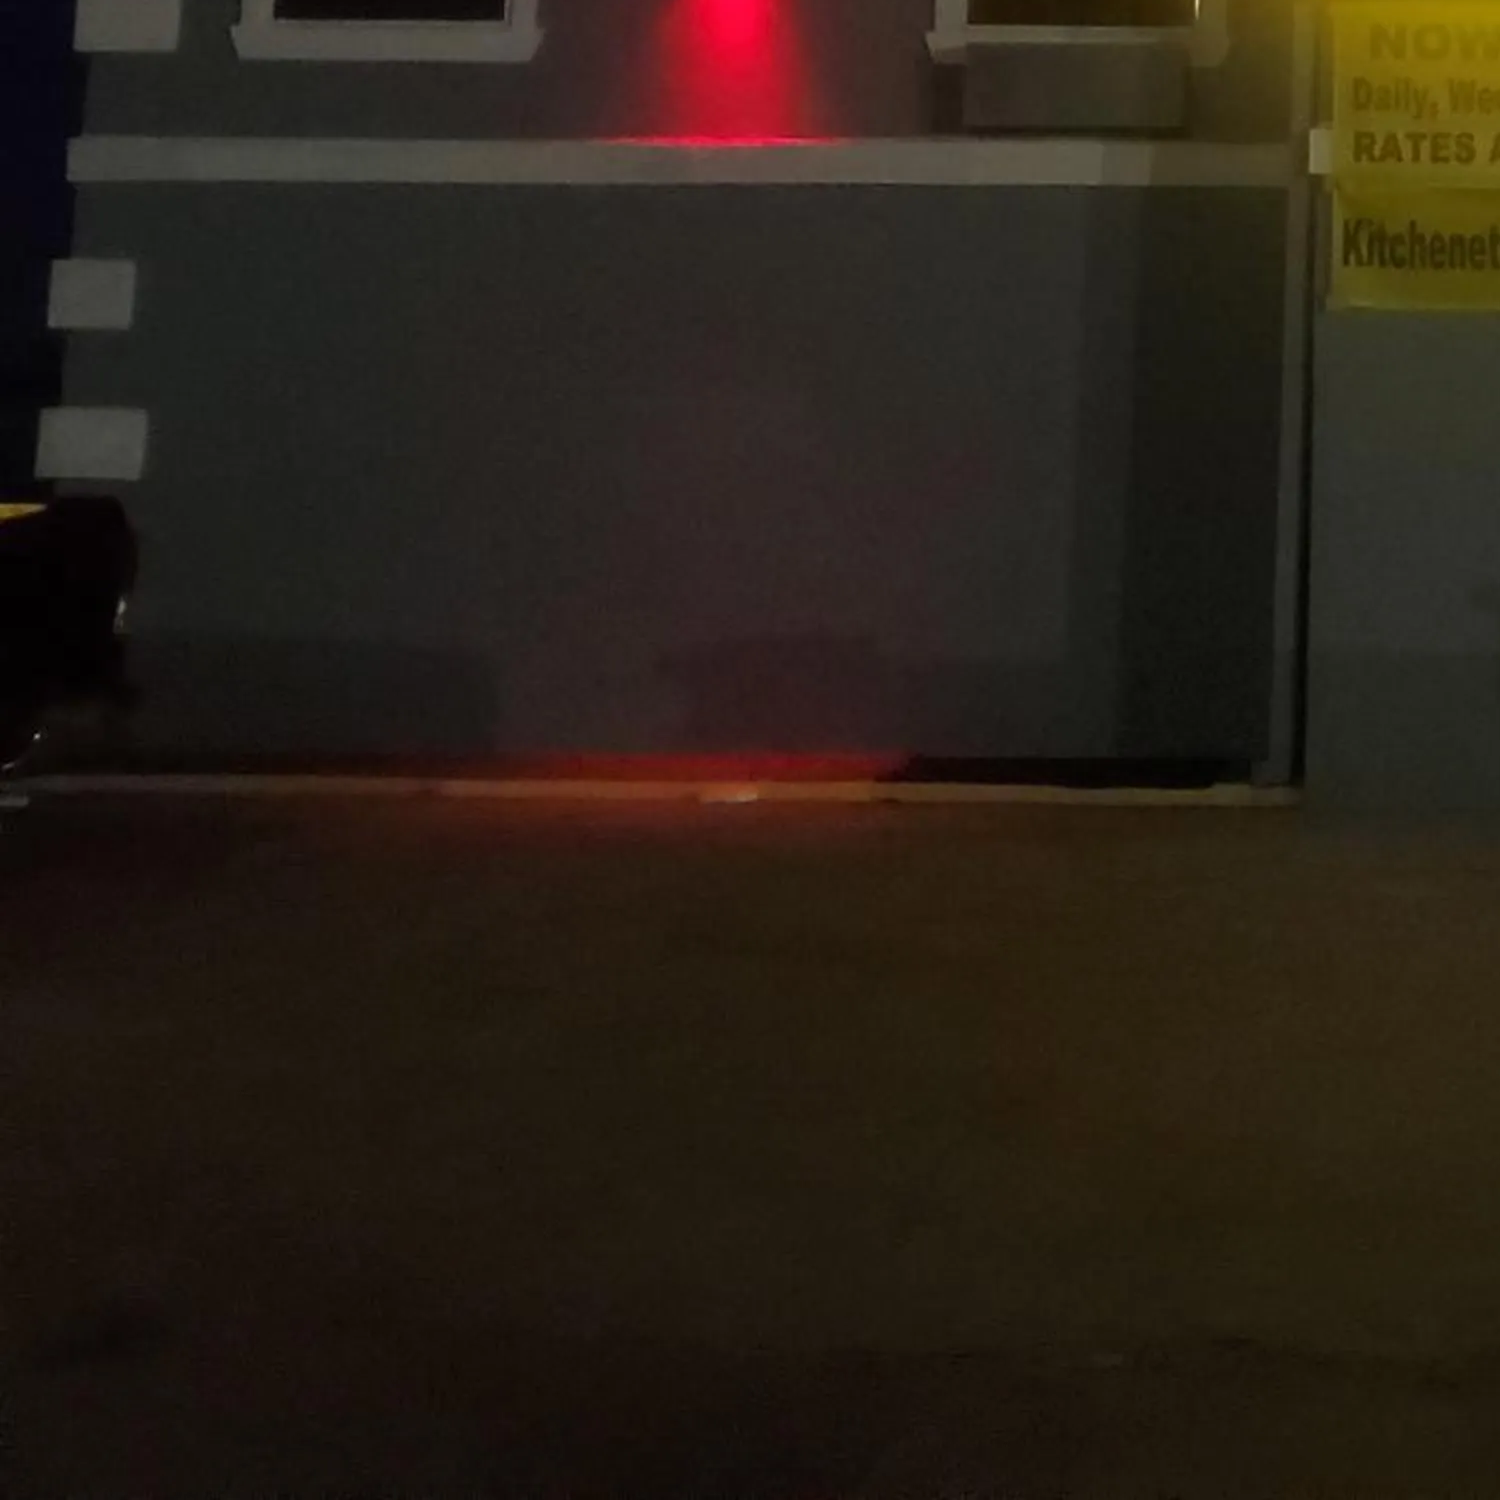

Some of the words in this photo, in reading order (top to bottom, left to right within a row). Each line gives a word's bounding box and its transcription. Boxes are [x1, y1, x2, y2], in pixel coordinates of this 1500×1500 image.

[1369, 22, 1500, 62] NOW
[1353, 77, 1440, 120] Daily,
[1352, 130, 1476, 164] RATES
